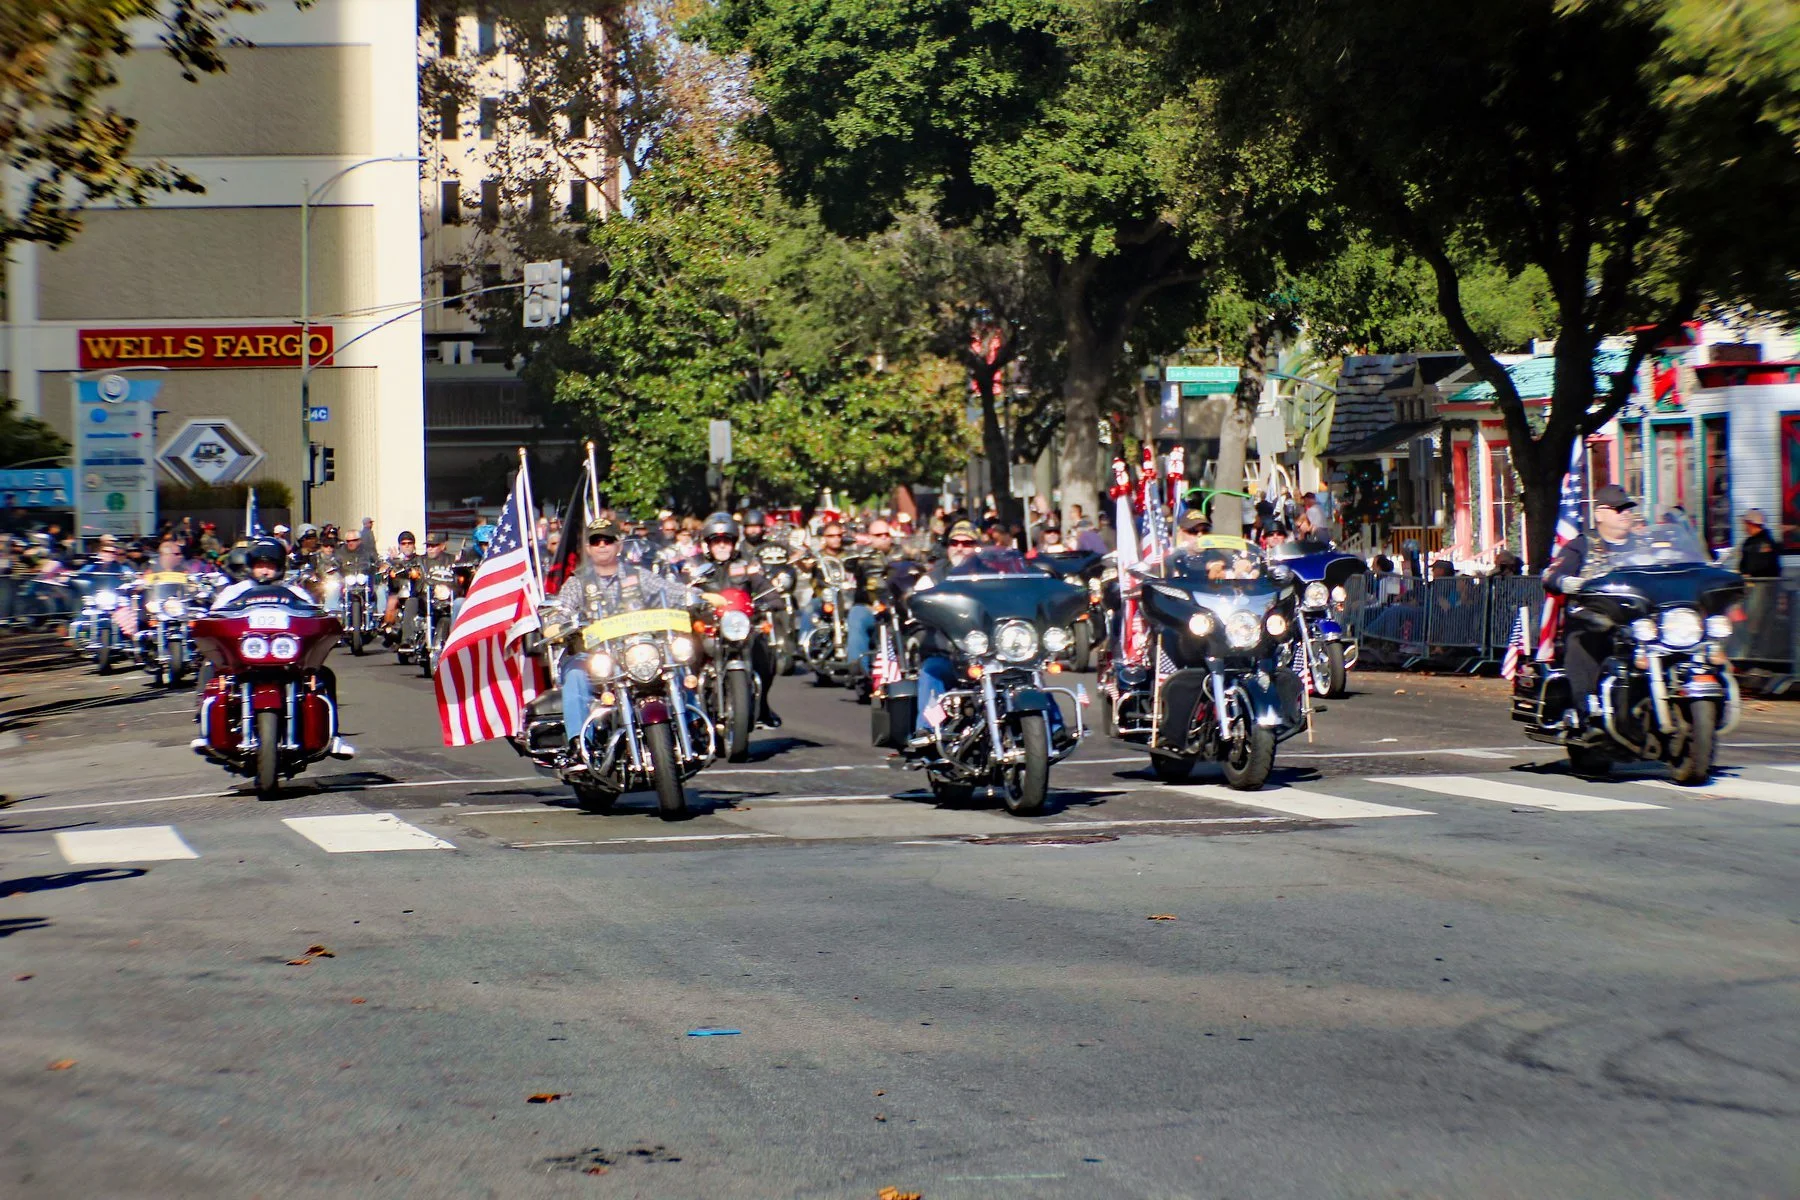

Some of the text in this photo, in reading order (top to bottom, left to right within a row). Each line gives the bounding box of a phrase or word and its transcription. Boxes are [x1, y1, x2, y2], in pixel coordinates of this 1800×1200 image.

[83, 334, 329, 359] WELLS FARGO
[311, 409, 327, 420] 4C
